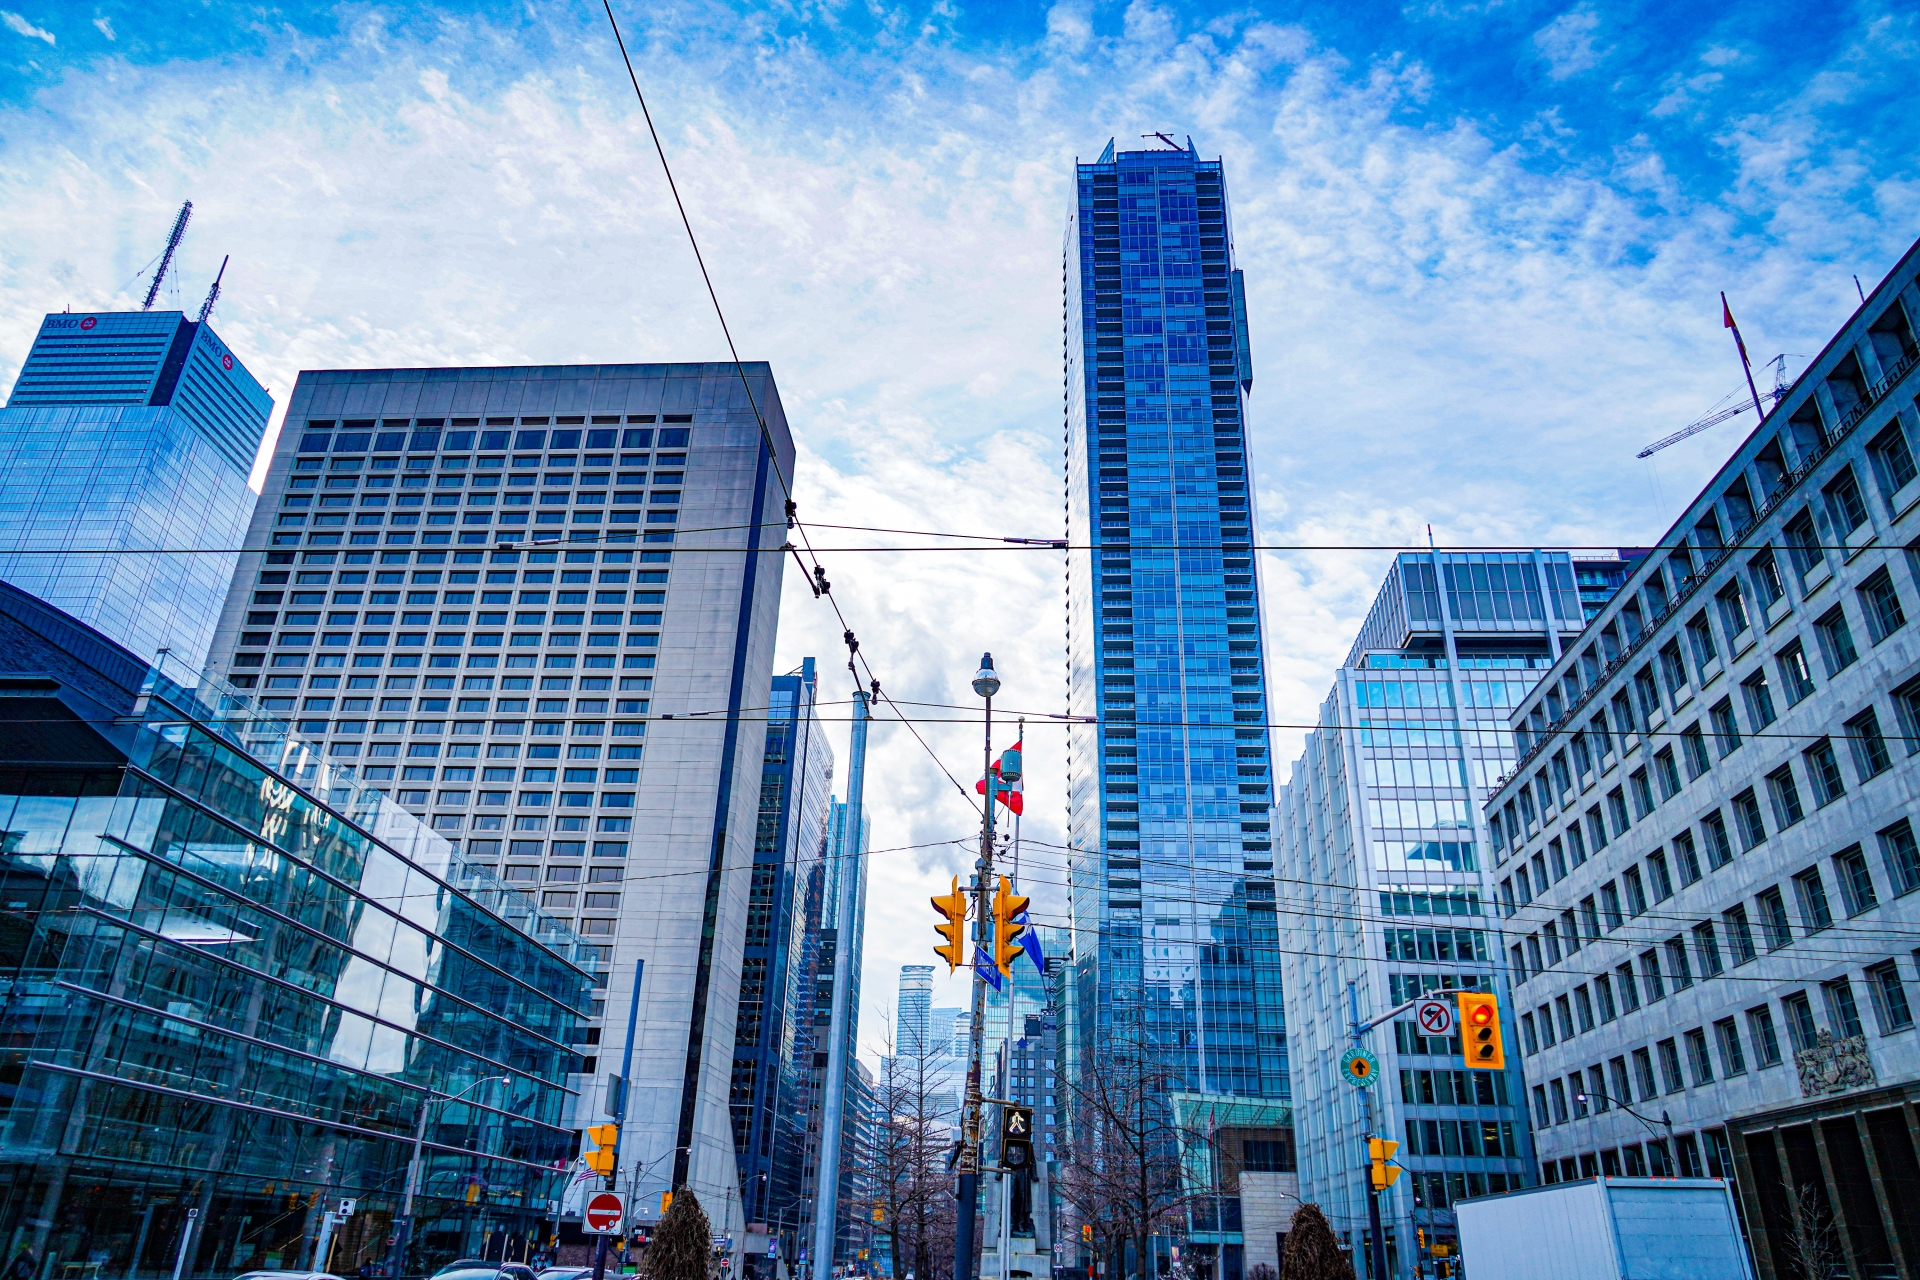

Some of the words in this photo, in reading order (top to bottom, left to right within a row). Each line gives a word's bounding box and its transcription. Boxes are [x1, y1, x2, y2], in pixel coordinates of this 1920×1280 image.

[45, 319, 78, 329] BMO
[200, 329, 222, 358] BMO
[1342, 1049, 1376, 1064] GARDINER
[1341, 1068, 1379, 1087] EXPRESSWAY
